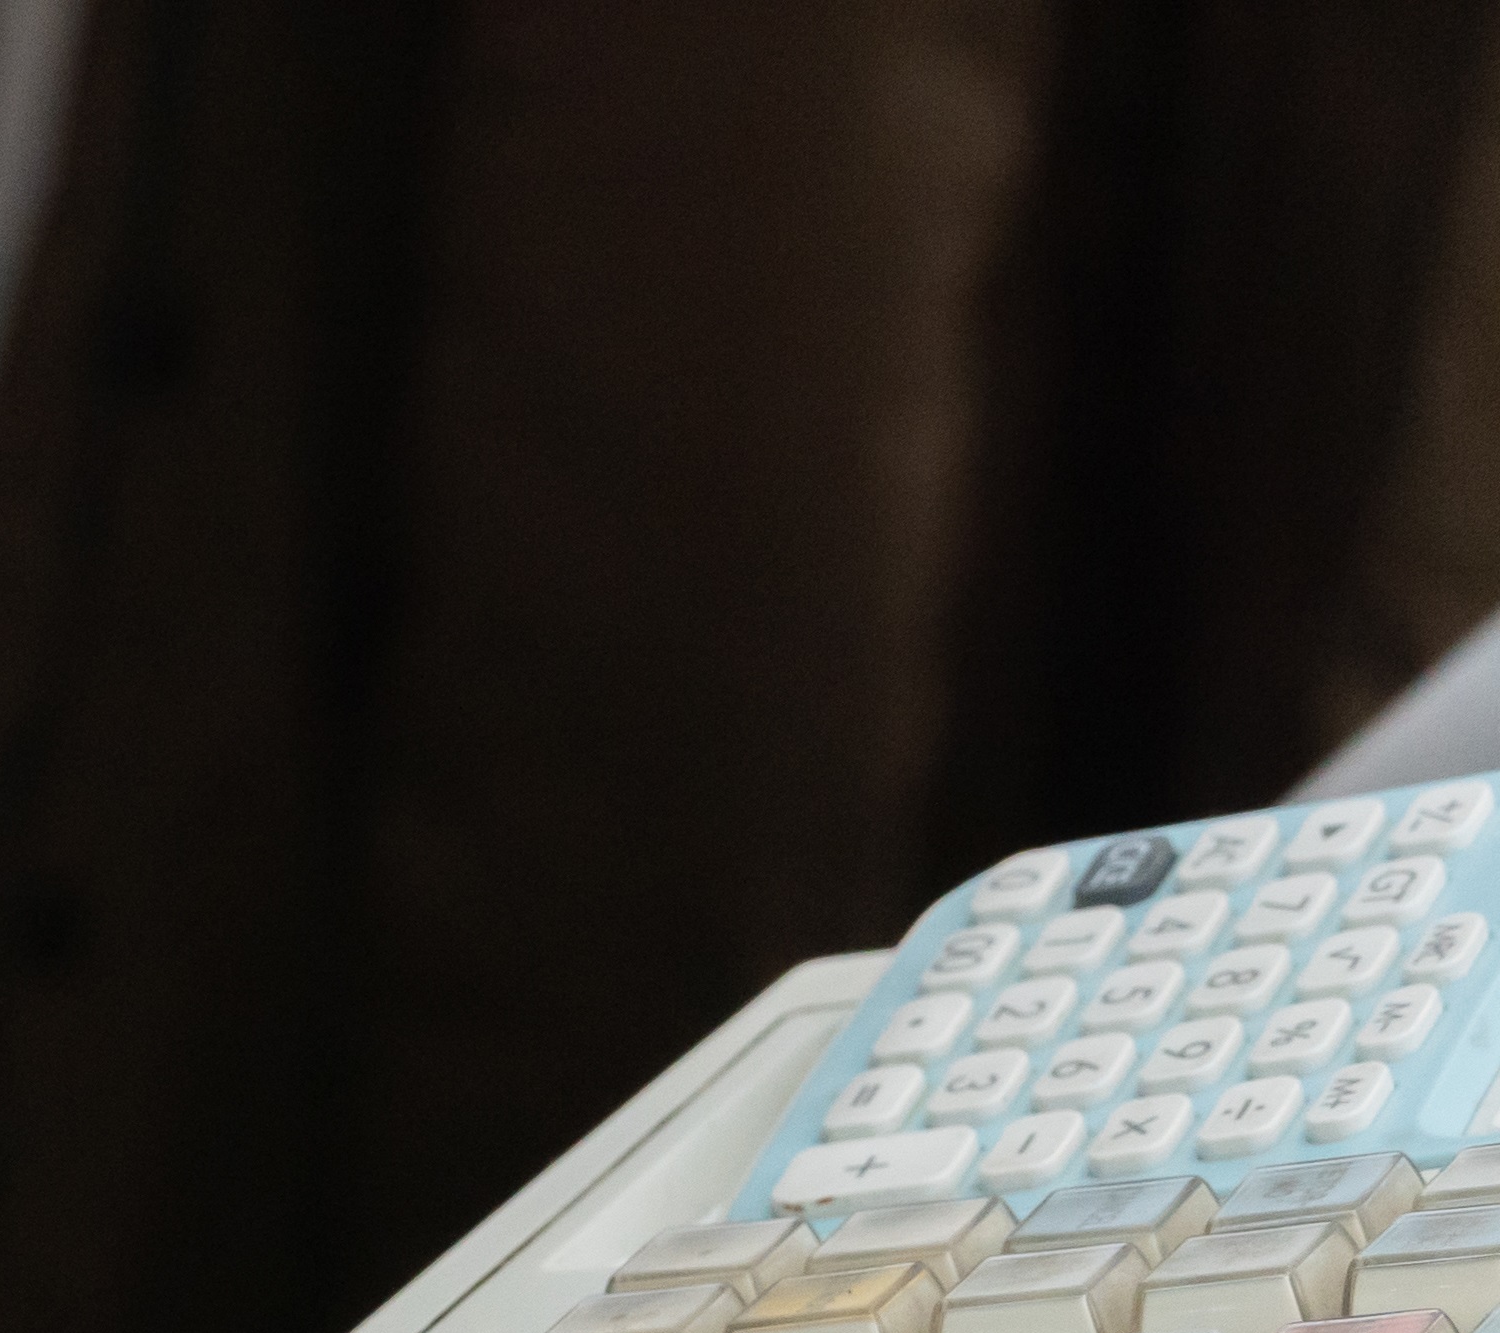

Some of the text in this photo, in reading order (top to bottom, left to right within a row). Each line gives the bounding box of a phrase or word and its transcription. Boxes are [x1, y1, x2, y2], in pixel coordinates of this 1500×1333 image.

[988, 867, 1040, 892] 0
[1361, 868, 1418, 904] GT
[1259, 894, 1311, 913] 7
[1148, 917, 1193, 936] 4
[930, 931, 995, 974] 00
[1205, 968, 1261, 990] 8
[1099, 986, 1154, 1006] 5
[990, 1000, 1047, 1022] 2
[1163, 1040, 1213, 1060] 9
[1049, 1059, 1100, 1080] 6
[944, 1073, 999, 1094] 3
[1324, 1077, 1362, 1110] M+
